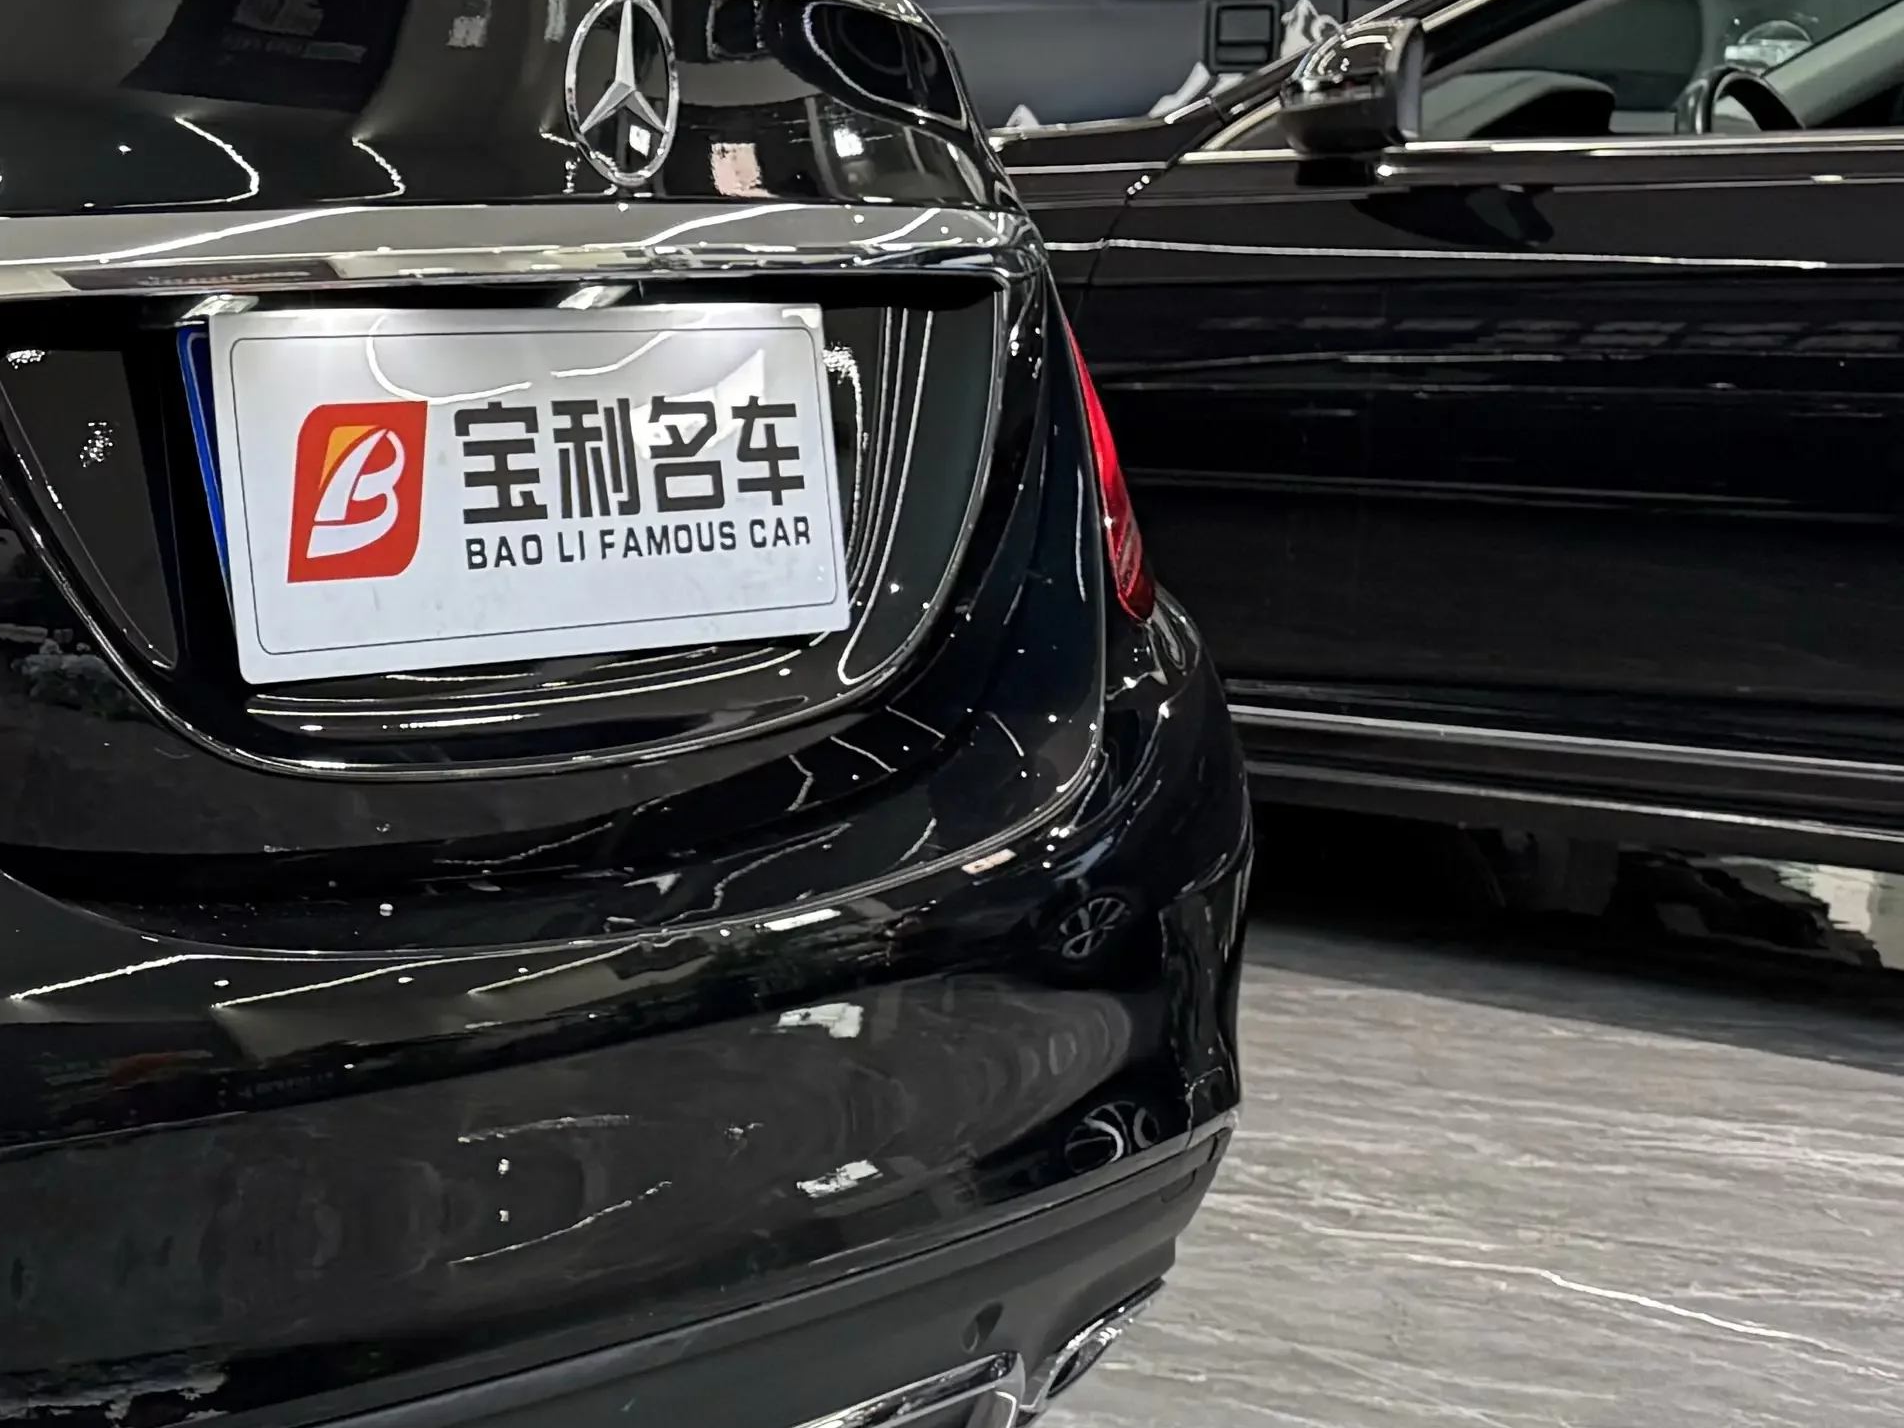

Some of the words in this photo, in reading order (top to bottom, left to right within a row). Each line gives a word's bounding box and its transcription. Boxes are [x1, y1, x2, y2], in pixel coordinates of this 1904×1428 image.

[454, 395, 806, 525] 宝利名车
[465, 533, 544, 570] BAO
[557, 529, 587, 563] LI
[600, 518, 738, 560] FAMOUS
[749, 515, 812, 549] CAR
